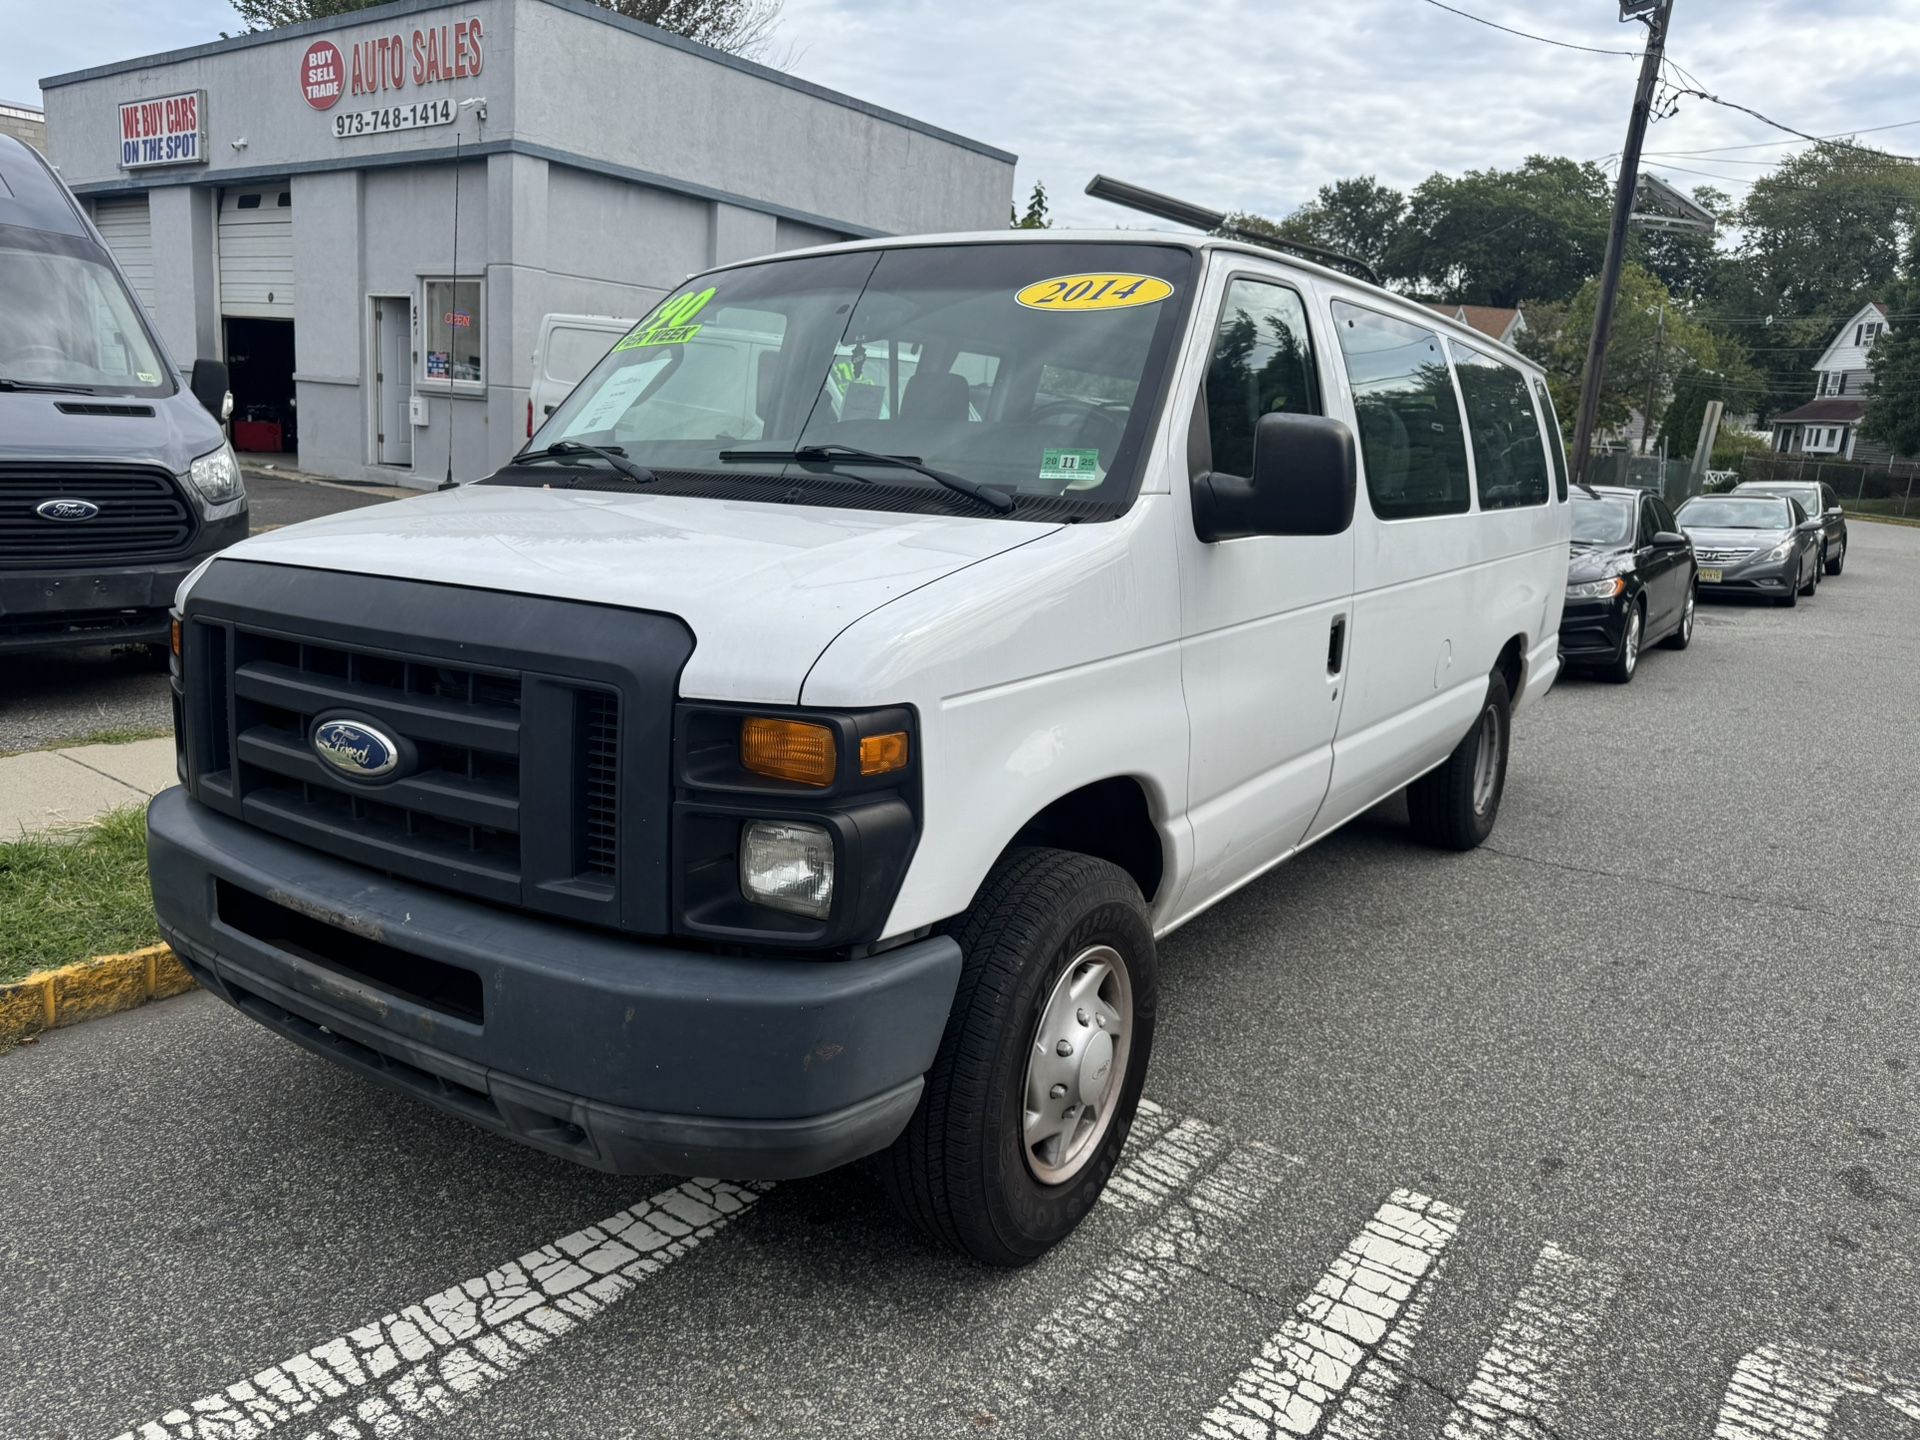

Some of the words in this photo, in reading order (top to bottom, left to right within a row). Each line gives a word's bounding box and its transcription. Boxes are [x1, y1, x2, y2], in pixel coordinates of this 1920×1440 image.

[308, 49, 333, 67] BUY
[352, 34, 404, 96] AUTO
[412, 16, 483, 85] SALES
[308, 65, 336, 83] SELL
[306, 81, 339, 100] TRADE
[121, 105, 141, 140] WE
[141, 101, 163, 138] BUY
[166, 95, 197, 135] CARS
[336, 99, 451, 136] 973-748-1414
[123, 140, 139, 164] ON
[141, 137, 164, 162] THE
[166, 132, 197, 160] SPOT
[1033, 278, 1149, 304] 2014
[444, 312, 471, 327] OPEN
[617, 331, 648, 348] PER
[646, 324, 701, 345] WEEK
[1045, 457, 1058, 465] 20
[1061, 456, 1076, 469] 11
[1080, 458, 1095, 466] 25
[53, 503, 86, 517] Ford
[330, 725, 371, 765] Ford
